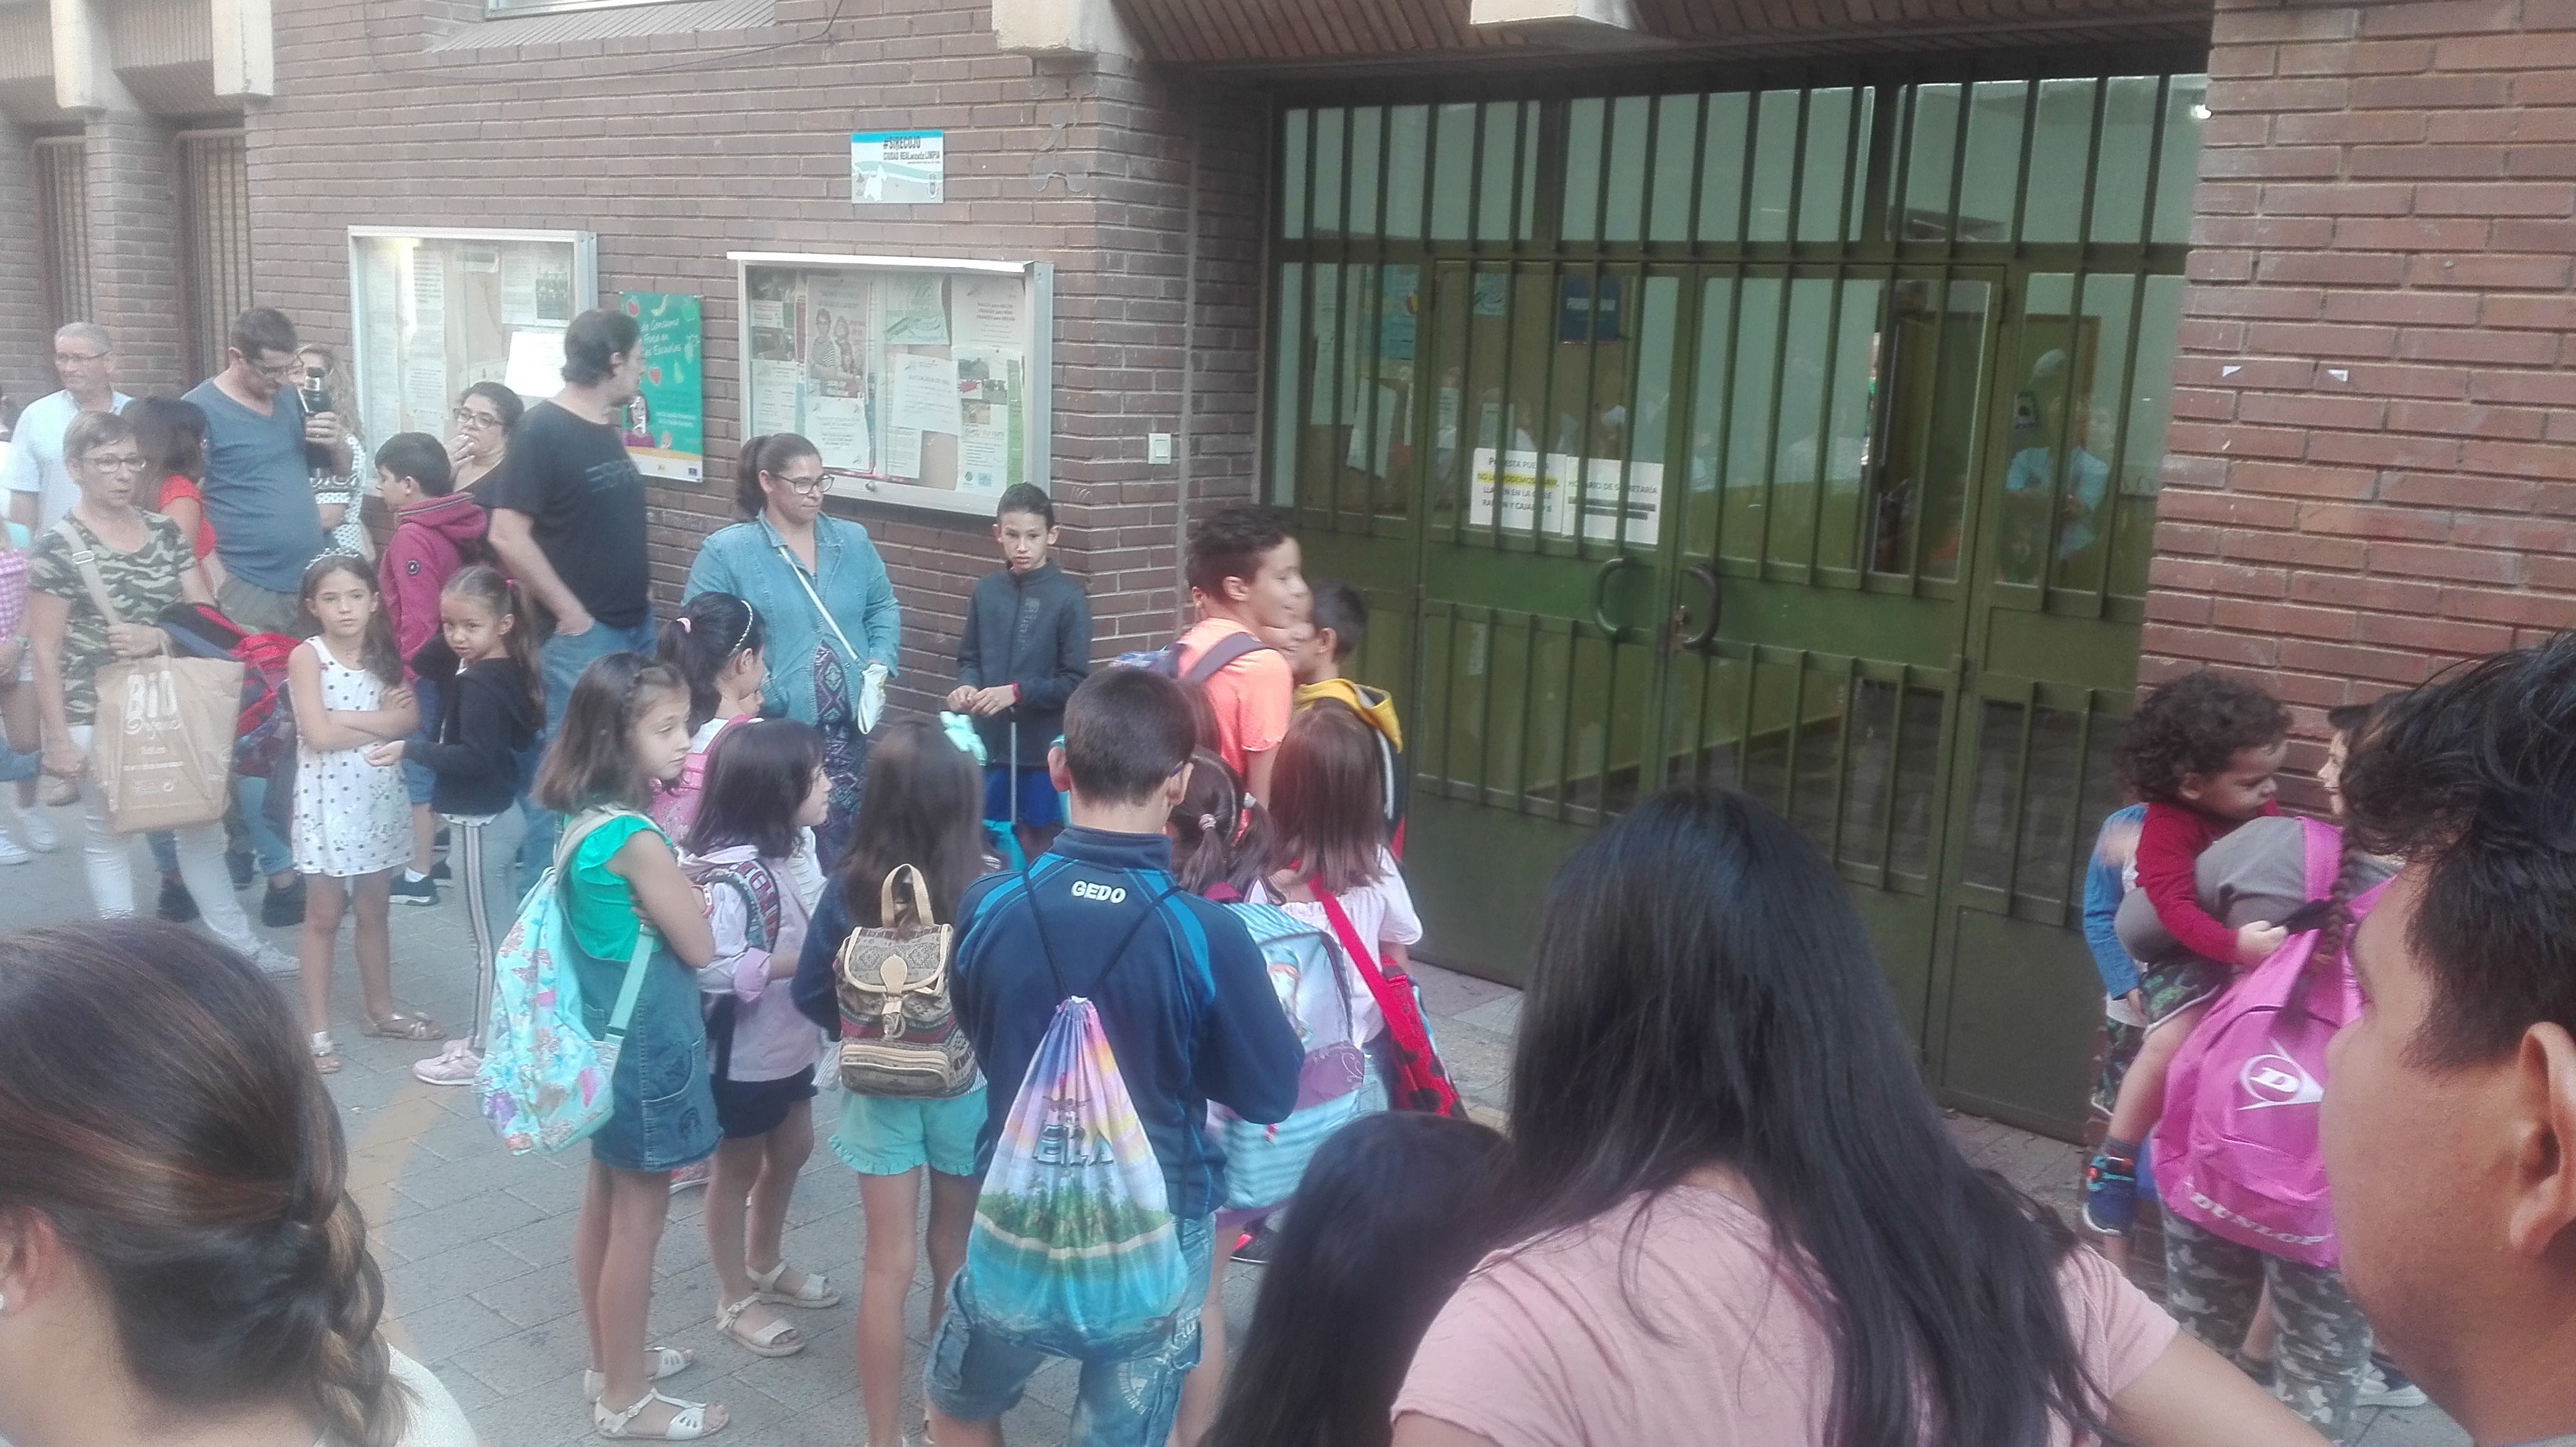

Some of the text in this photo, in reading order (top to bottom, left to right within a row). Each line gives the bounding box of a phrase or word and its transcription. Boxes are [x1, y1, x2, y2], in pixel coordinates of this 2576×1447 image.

[1477, 473, 1487, 481] NO
[1603, 482, 1614, 491] DE
[1071, 880, 1126, 904] GEDO
[2188, 1192, 2334, 1246] DUNLOP
